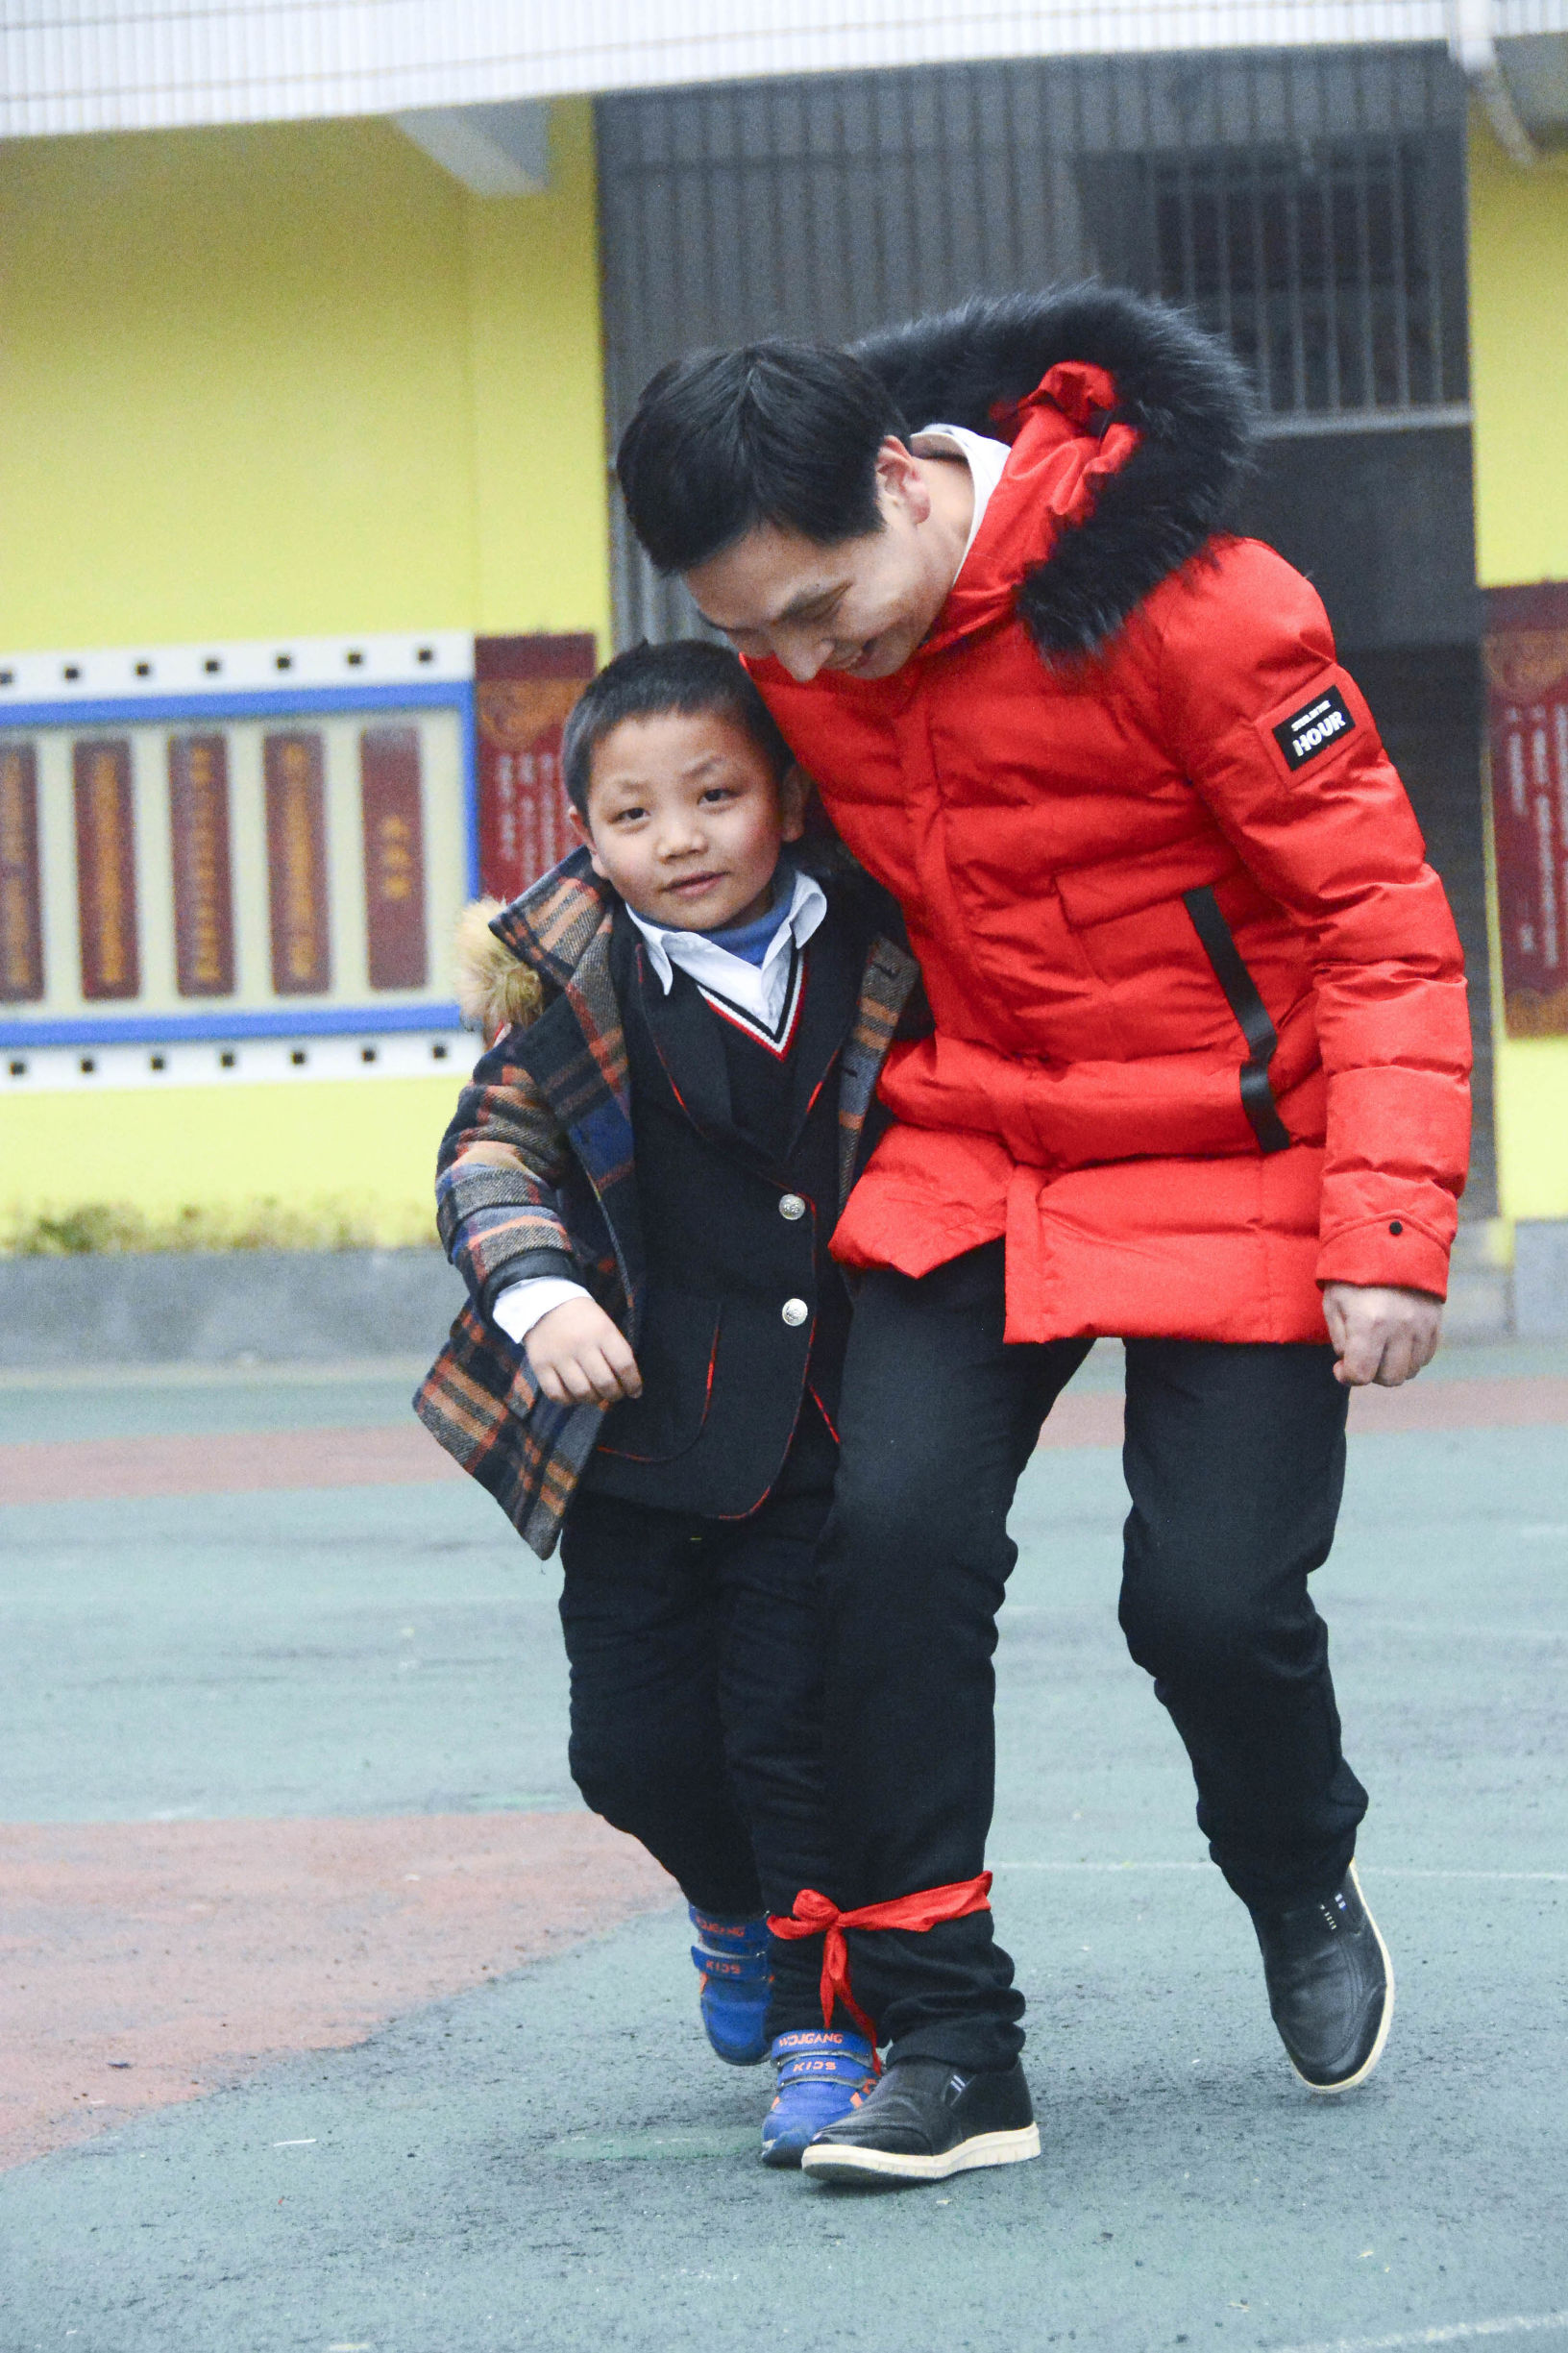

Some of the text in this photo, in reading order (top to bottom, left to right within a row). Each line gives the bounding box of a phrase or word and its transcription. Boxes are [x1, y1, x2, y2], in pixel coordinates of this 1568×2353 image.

[1292, 711, 1346, 757] HOUR
[705, 1959, 742, 1975] KIDS
[792, 2060, 837, 2072] KIDS
